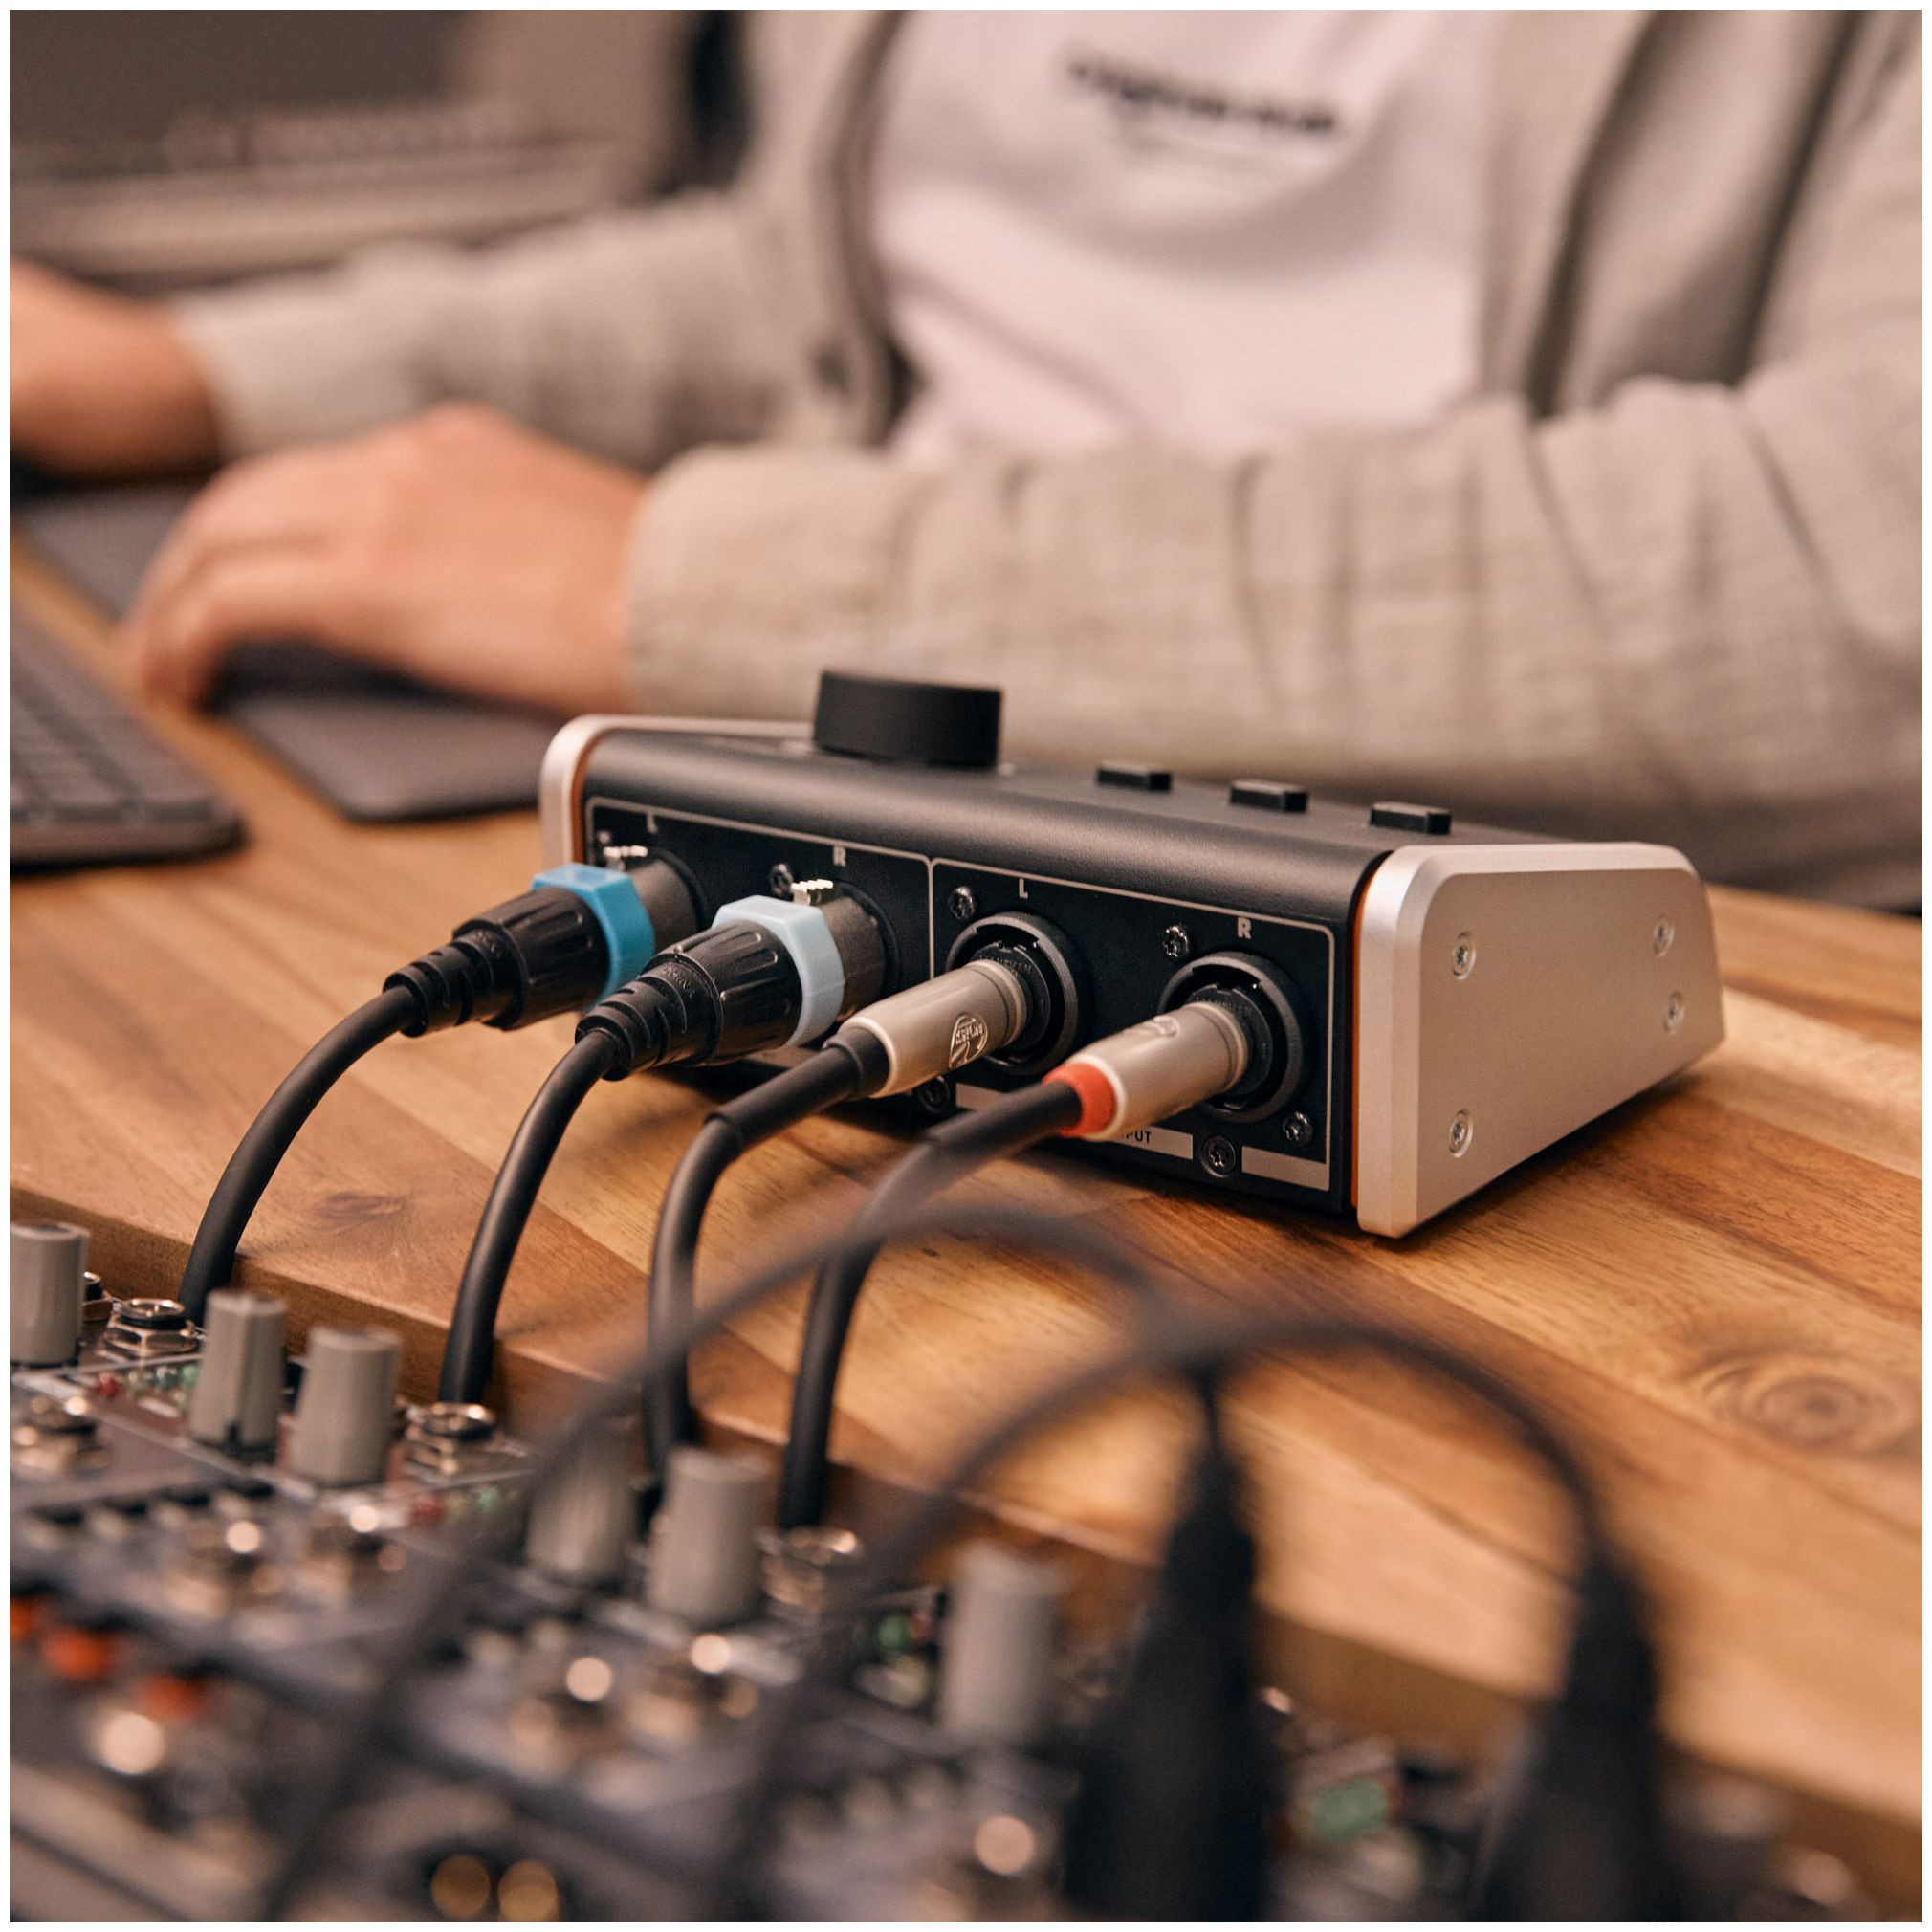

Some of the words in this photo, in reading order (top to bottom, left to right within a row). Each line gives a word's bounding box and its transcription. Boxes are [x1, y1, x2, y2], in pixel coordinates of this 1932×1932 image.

[646, 812, 659, 833] L
[833, 845, 846, 867] R
[1019, 878, 1029, 899] L
[1237, 917, 1252, 939] R
